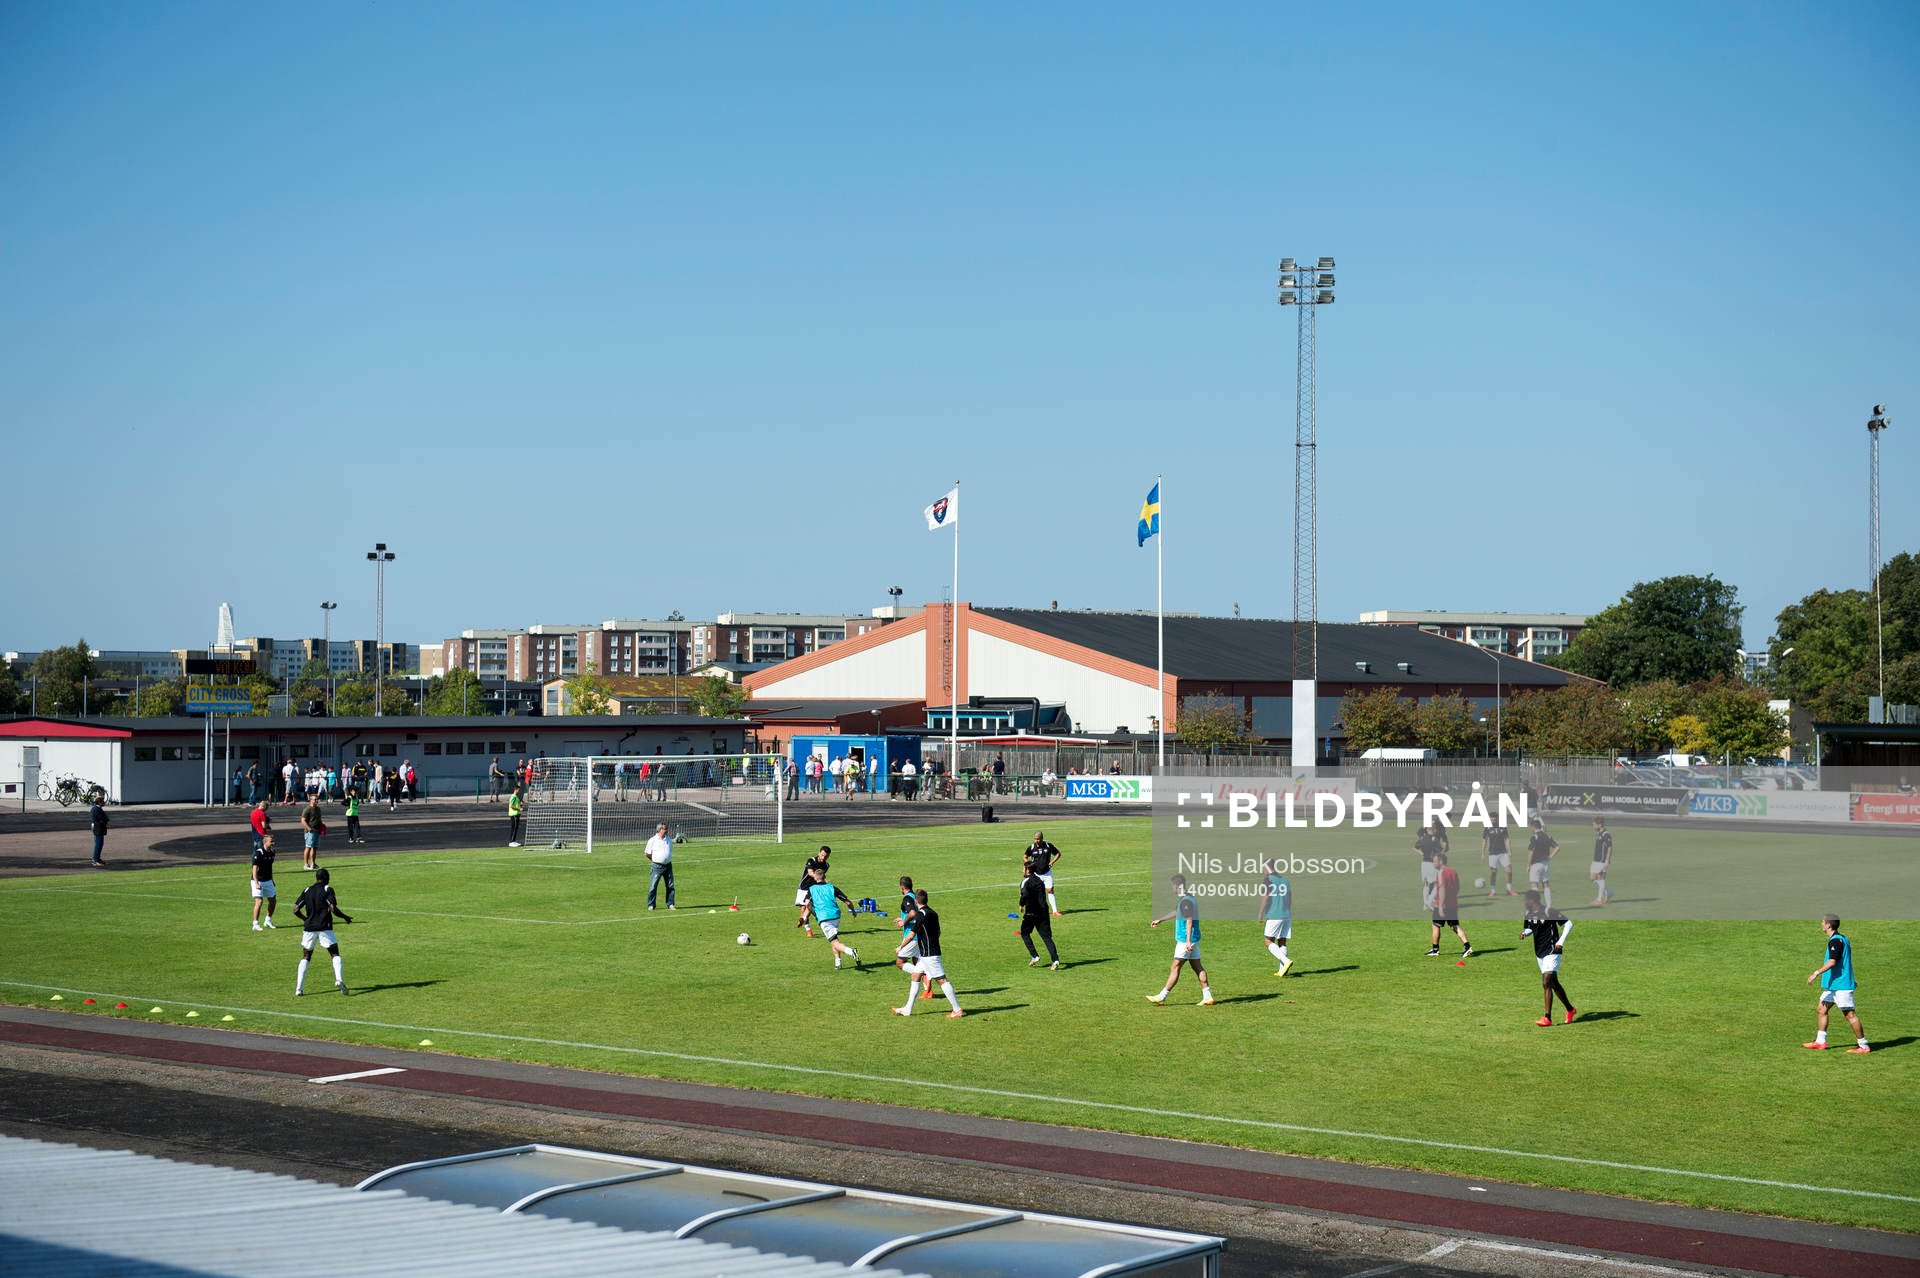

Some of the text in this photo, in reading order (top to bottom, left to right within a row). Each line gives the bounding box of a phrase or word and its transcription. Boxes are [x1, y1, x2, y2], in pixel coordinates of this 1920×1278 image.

[189, 687, 251, 701] CITY GROSS
[1071, 782, 1108, 796] MKB
[1601, 795, 1614, 804] DIN
[1615, 796, 1642, 805] MOBILA
[1694, 796, 1733, 812] MKB
[1863, 803, 1893, 816] Energi
[1896, 804, 1907, 814] till
